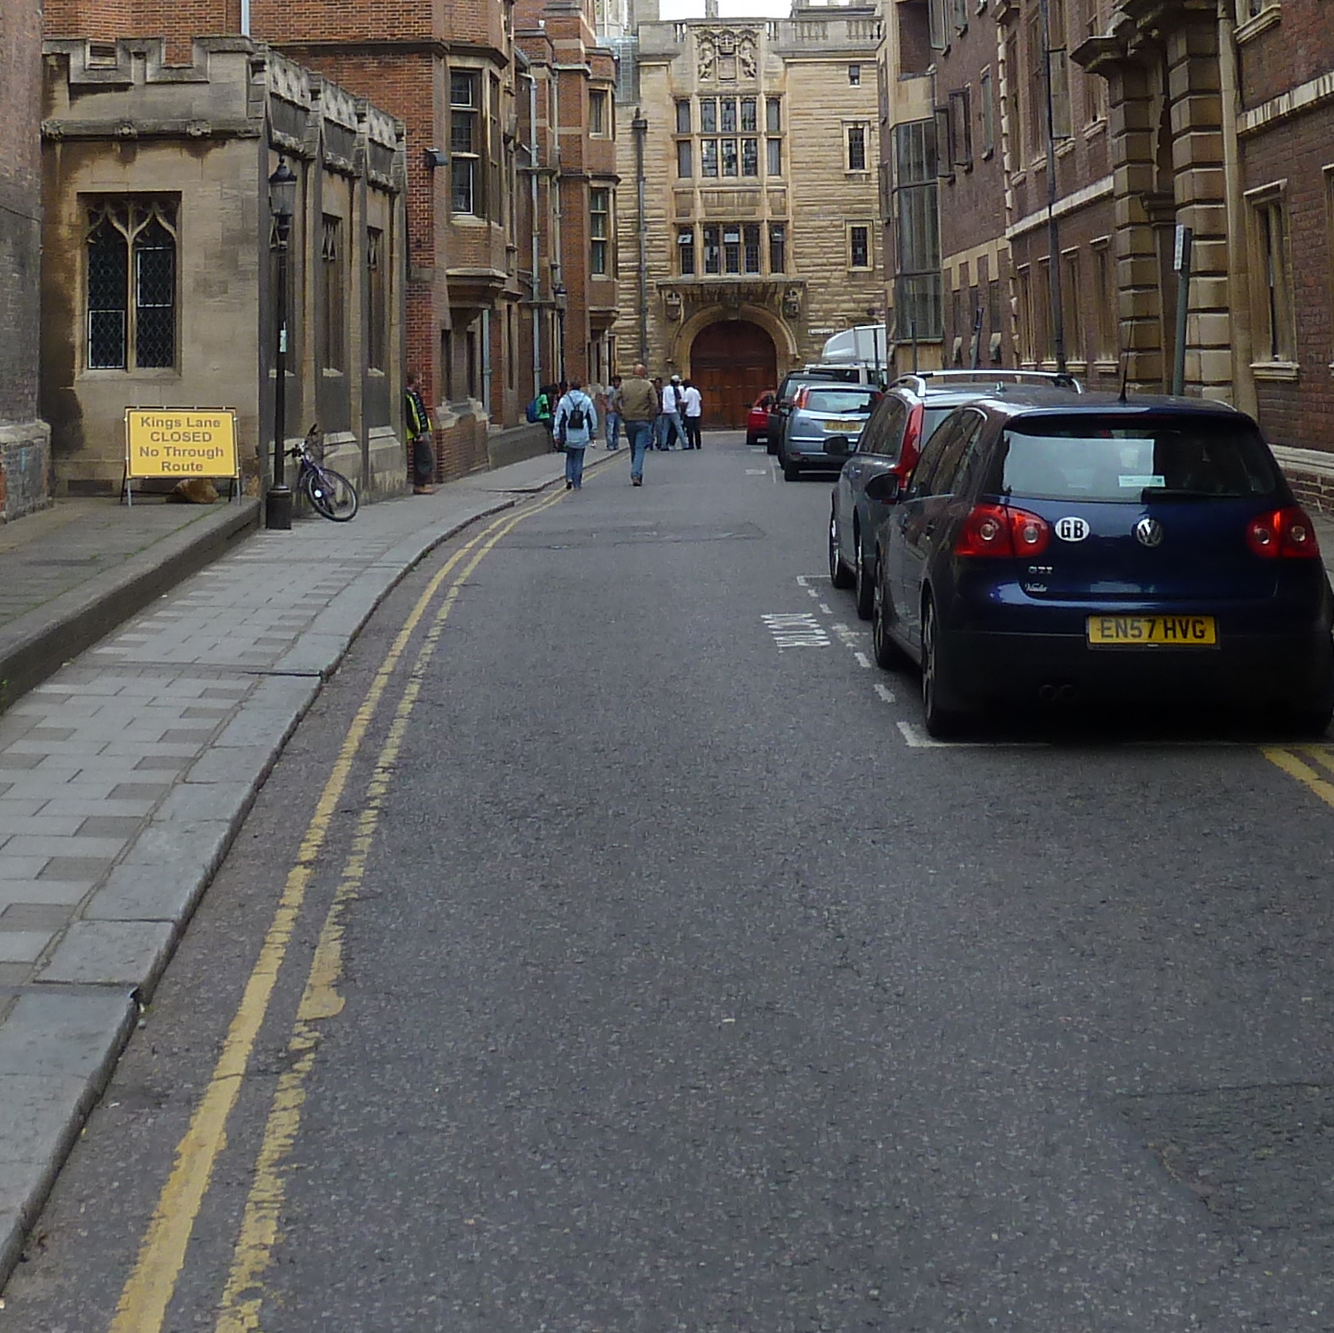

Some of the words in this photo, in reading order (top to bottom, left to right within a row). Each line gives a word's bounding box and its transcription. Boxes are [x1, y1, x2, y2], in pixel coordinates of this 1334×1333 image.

[140, 416, 182, 430] Kings
[186, 417, 221, 428] Lane
[150, 431, 212, 442] CLOSED
[139, 446, 159, 457] No
[163, 446, 224, 460] Through
[161, 461, 204, 472] Route
[1060, 519, 1084, 539] GB
[1028, 565, 1053, 574] GTI
[1100, 617, 1157, 639] EN57
[1162, 618, 1207, 639] HVG
